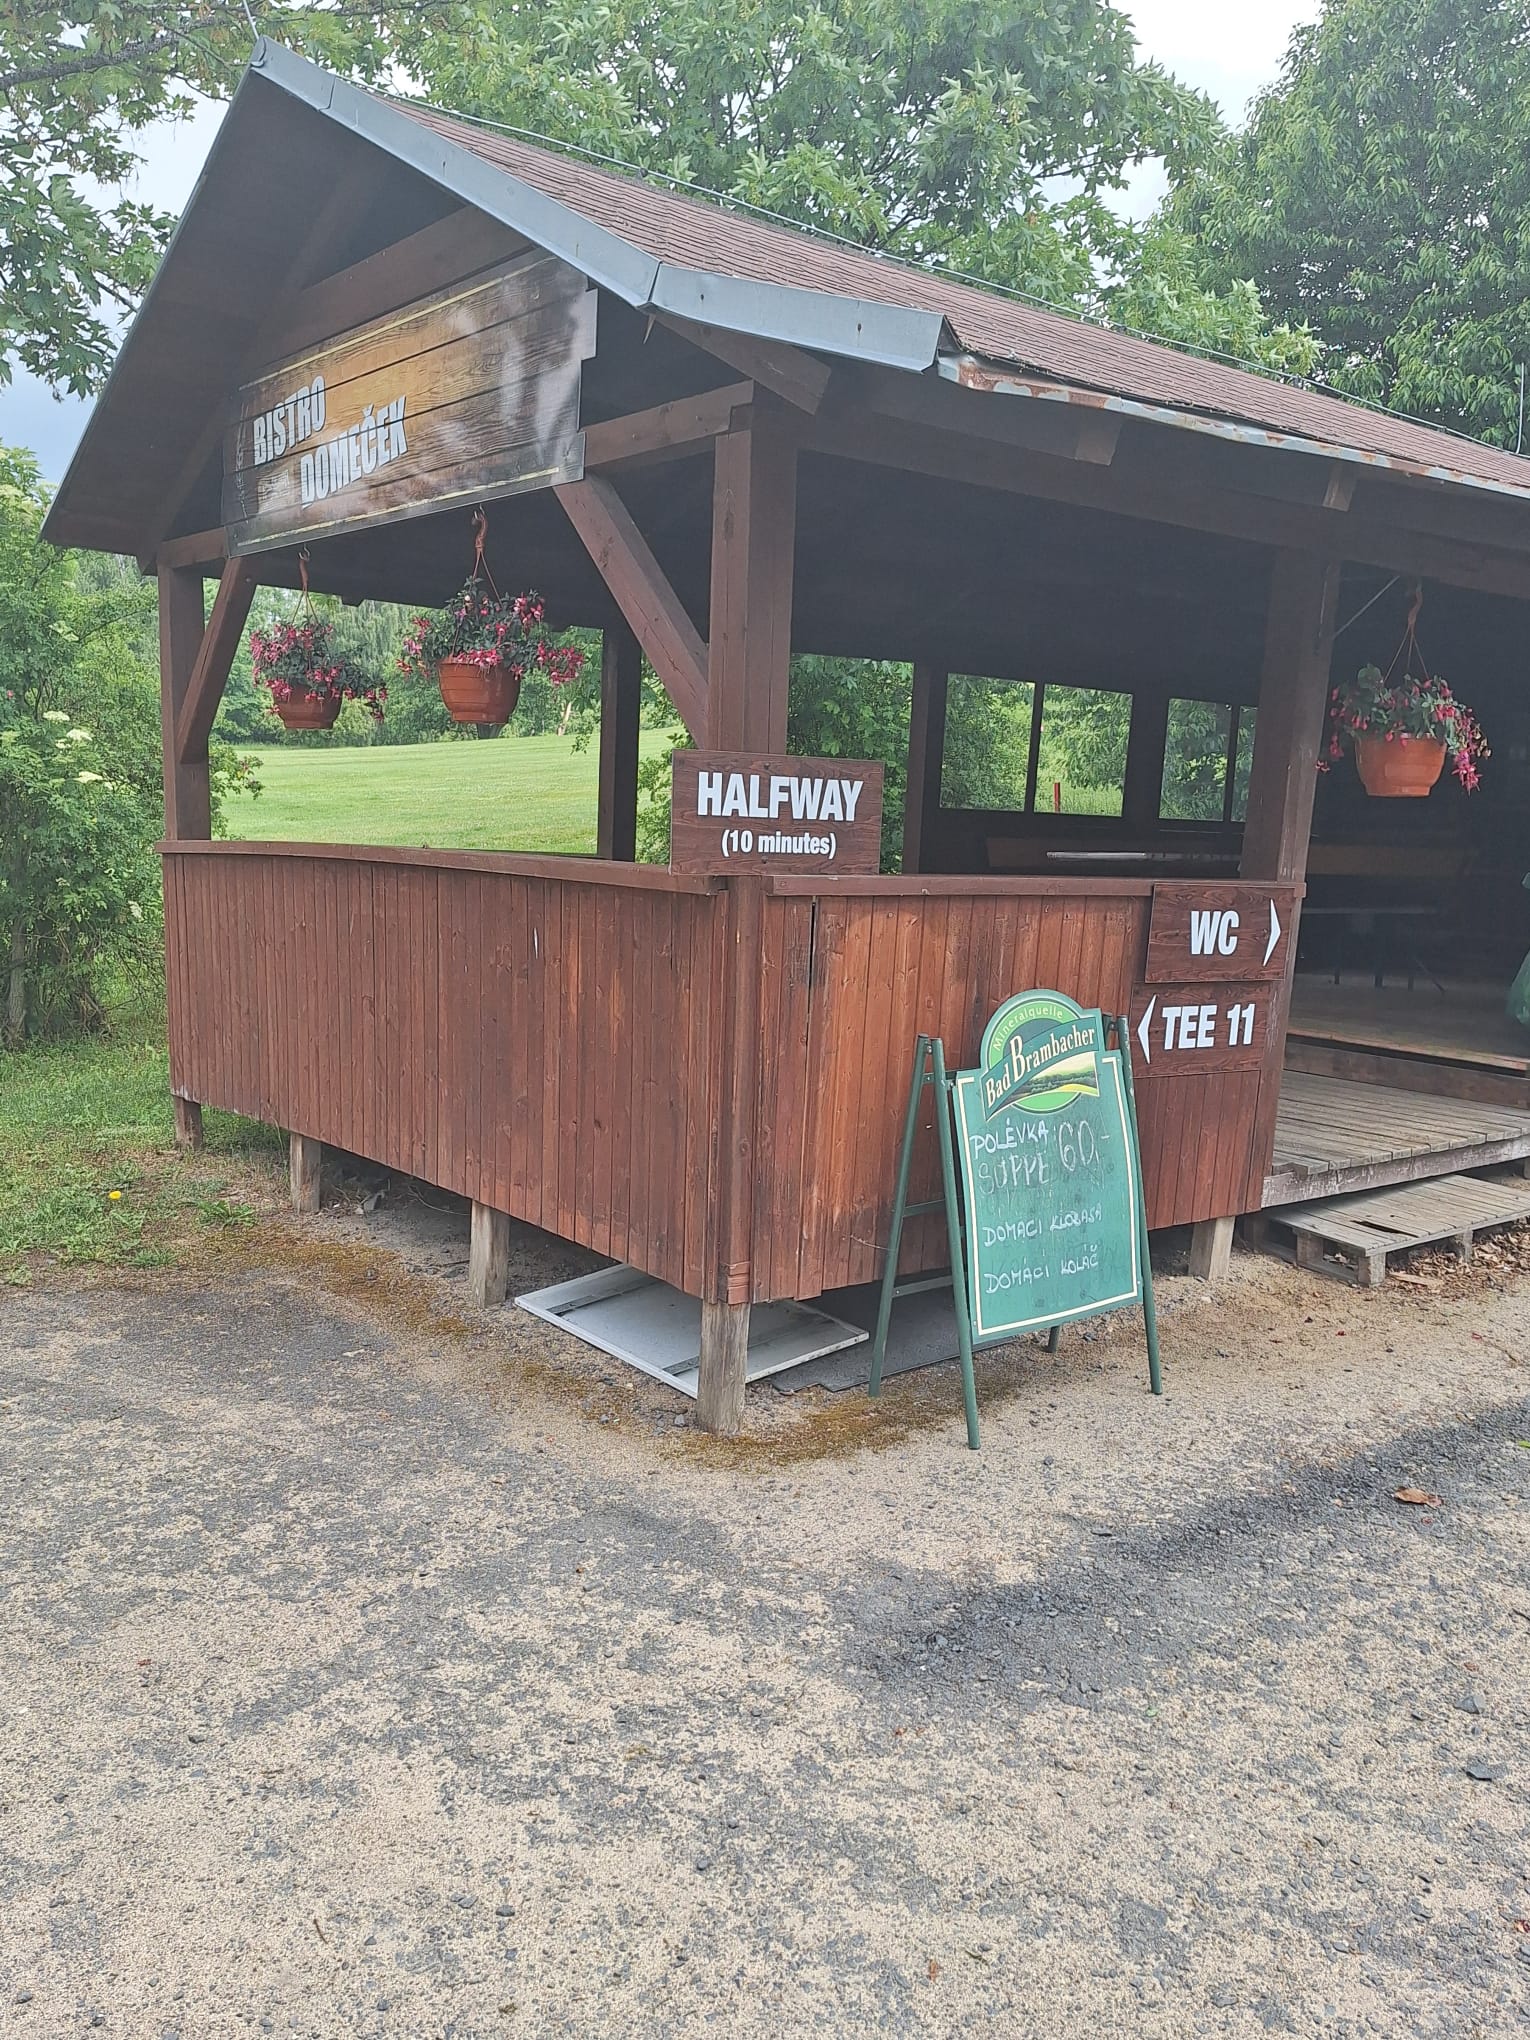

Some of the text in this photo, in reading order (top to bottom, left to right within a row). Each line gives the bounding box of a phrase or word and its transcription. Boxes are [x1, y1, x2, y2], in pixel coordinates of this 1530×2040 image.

[253, 375, 327, 466] BISTRO
[301, 395, 409, 509] DOMEČEK
[697, 771, 864, 822] HALFWAY
[721, 829, 837, 860] (10 minutes)
[1190, 910, 1240, 955] WC
[992, 1005, 1064, 1052] Mineralquelle
[1162, 1003, 1256, 1050] TEE 11
[985, 1025, 1096, 1109] Bad Brambacher
